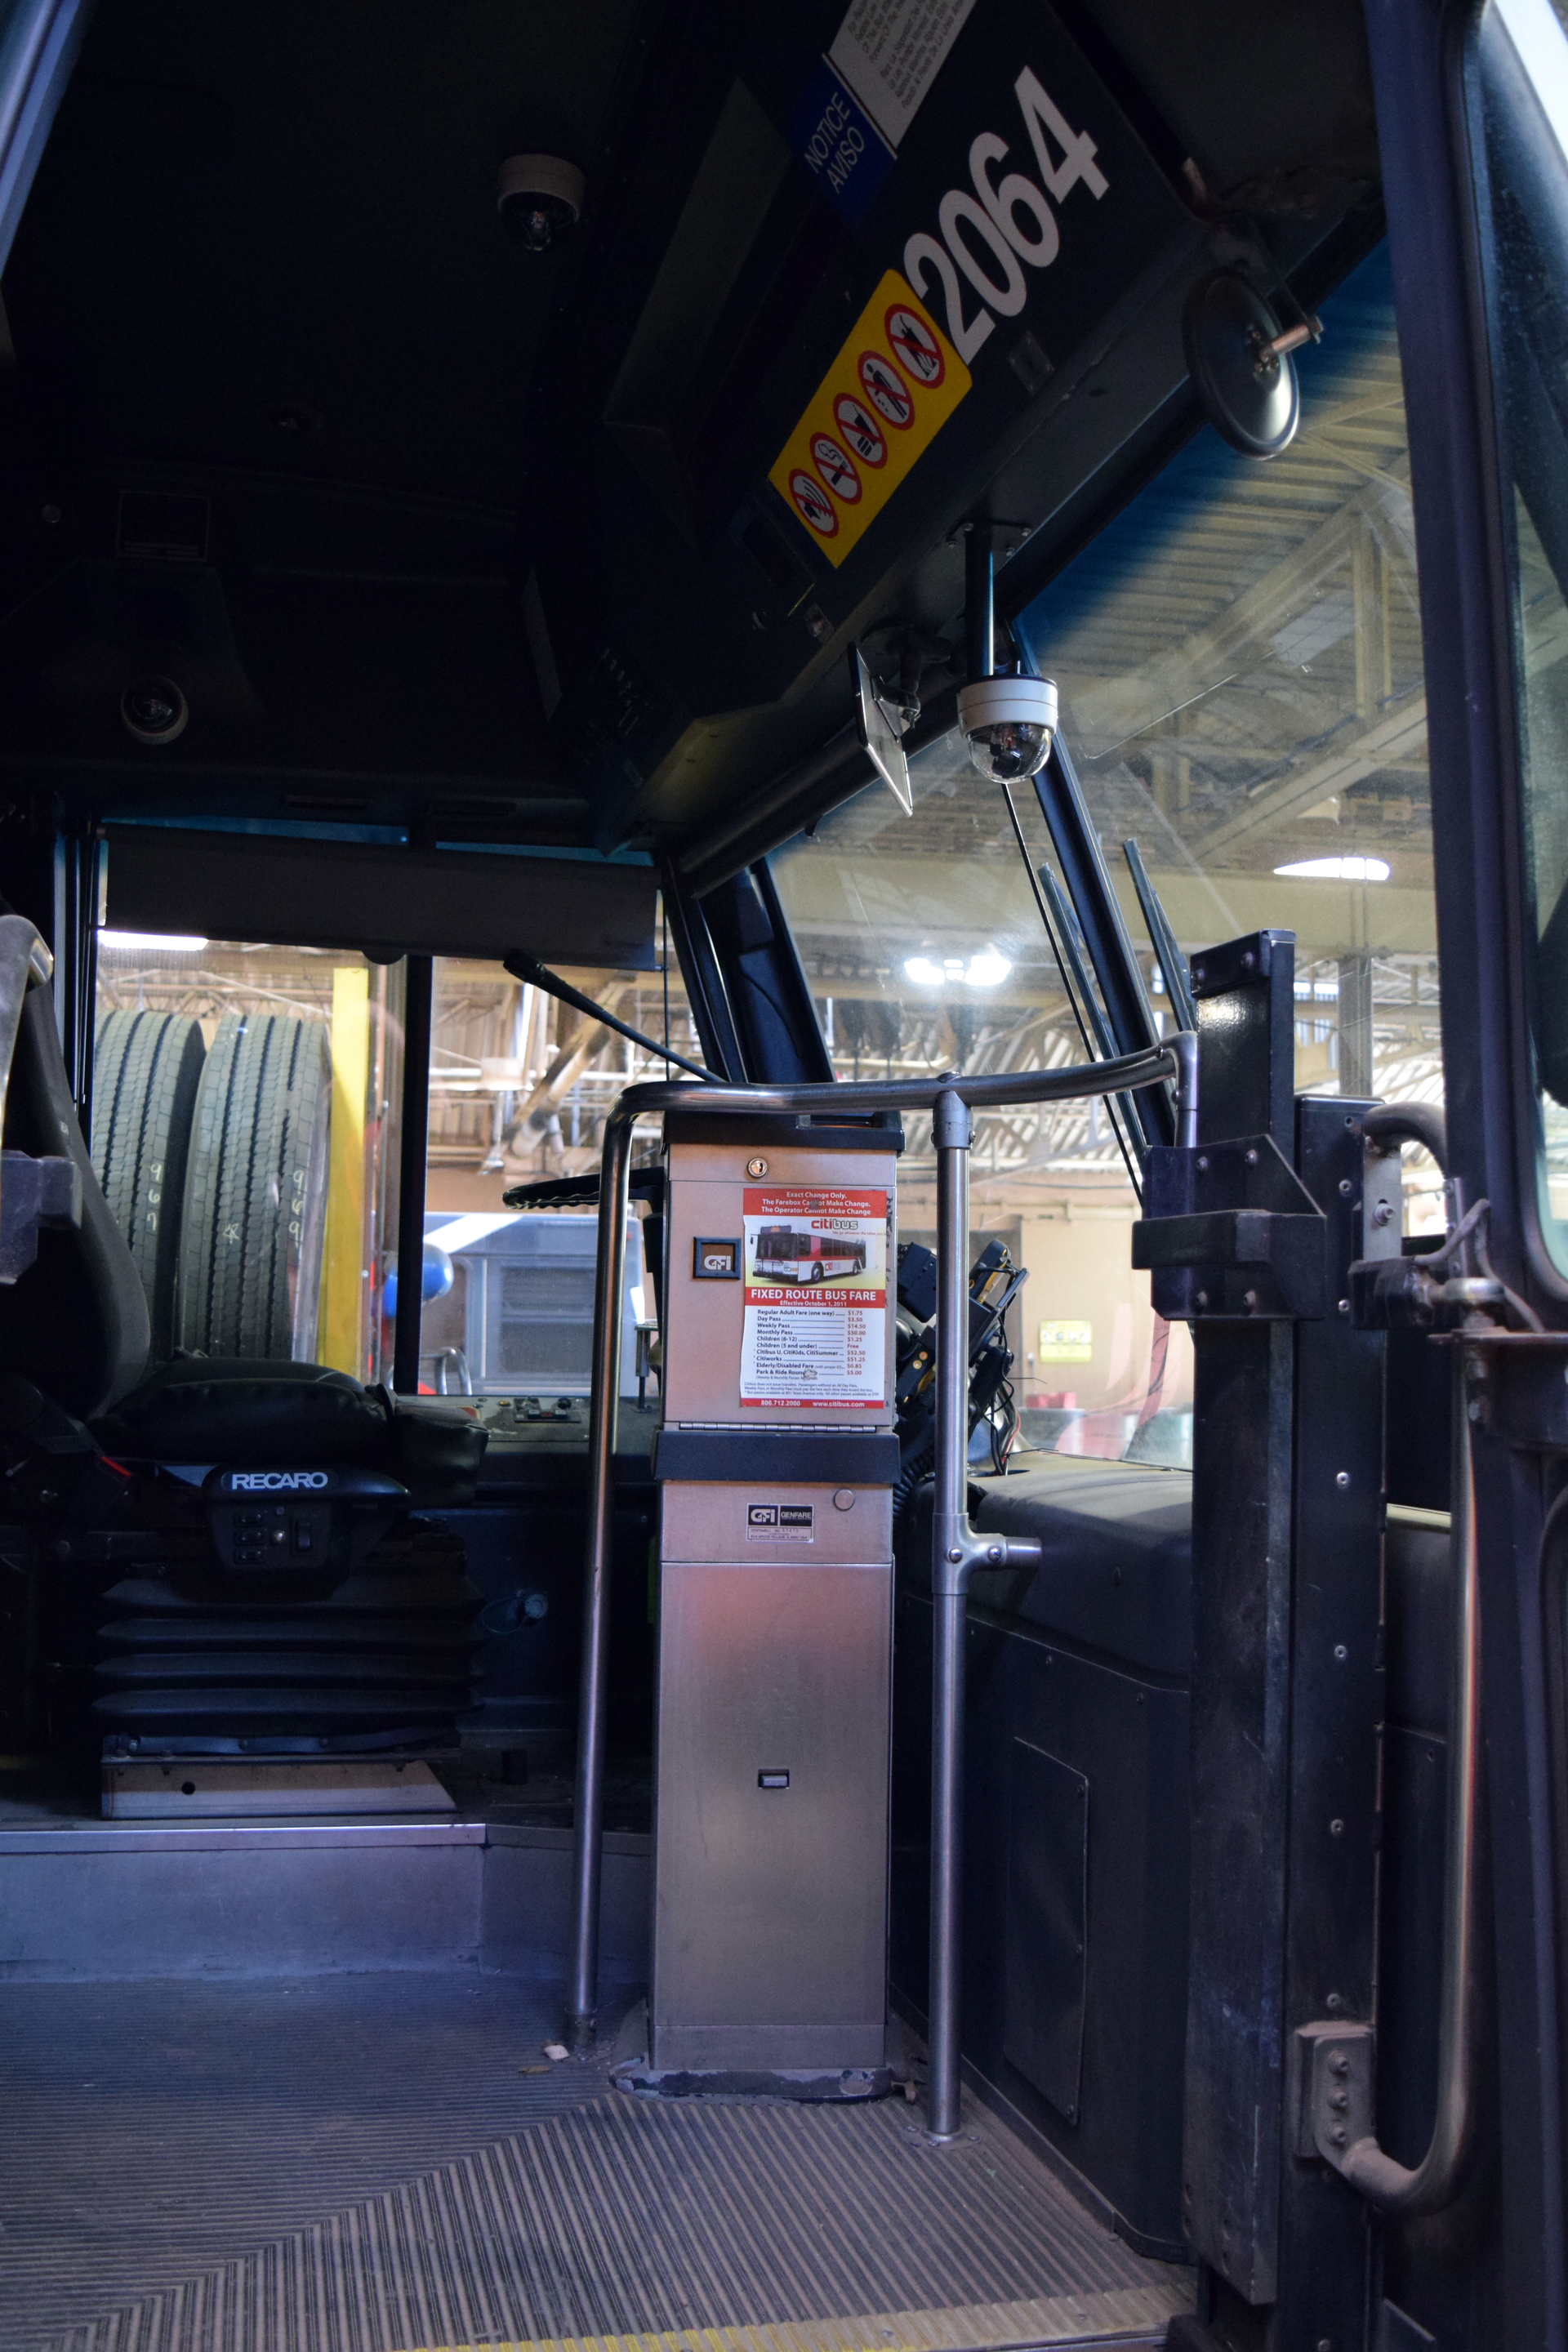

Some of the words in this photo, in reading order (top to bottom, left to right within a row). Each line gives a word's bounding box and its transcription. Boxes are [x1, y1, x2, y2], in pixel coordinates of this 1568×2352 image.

[804, 92, 851, 174] NOTICE
[826, 127, 865, 194] AVISO
[904, 65, 1109, 366] 2064
[774, 1206, 803, 1214] Operator
[846, 1208, 871, 1216] Change
[811, 1218, 858, 1230] citibus
[751, 1289, 783, 1298] FIXED
[786, 1290, 822, 1299] ROUTE
[825, 1291, 847, 1300] BUS
[849, 1291, 876, 1301] FARE
[232, 1472, 328, 1490] RECARO
